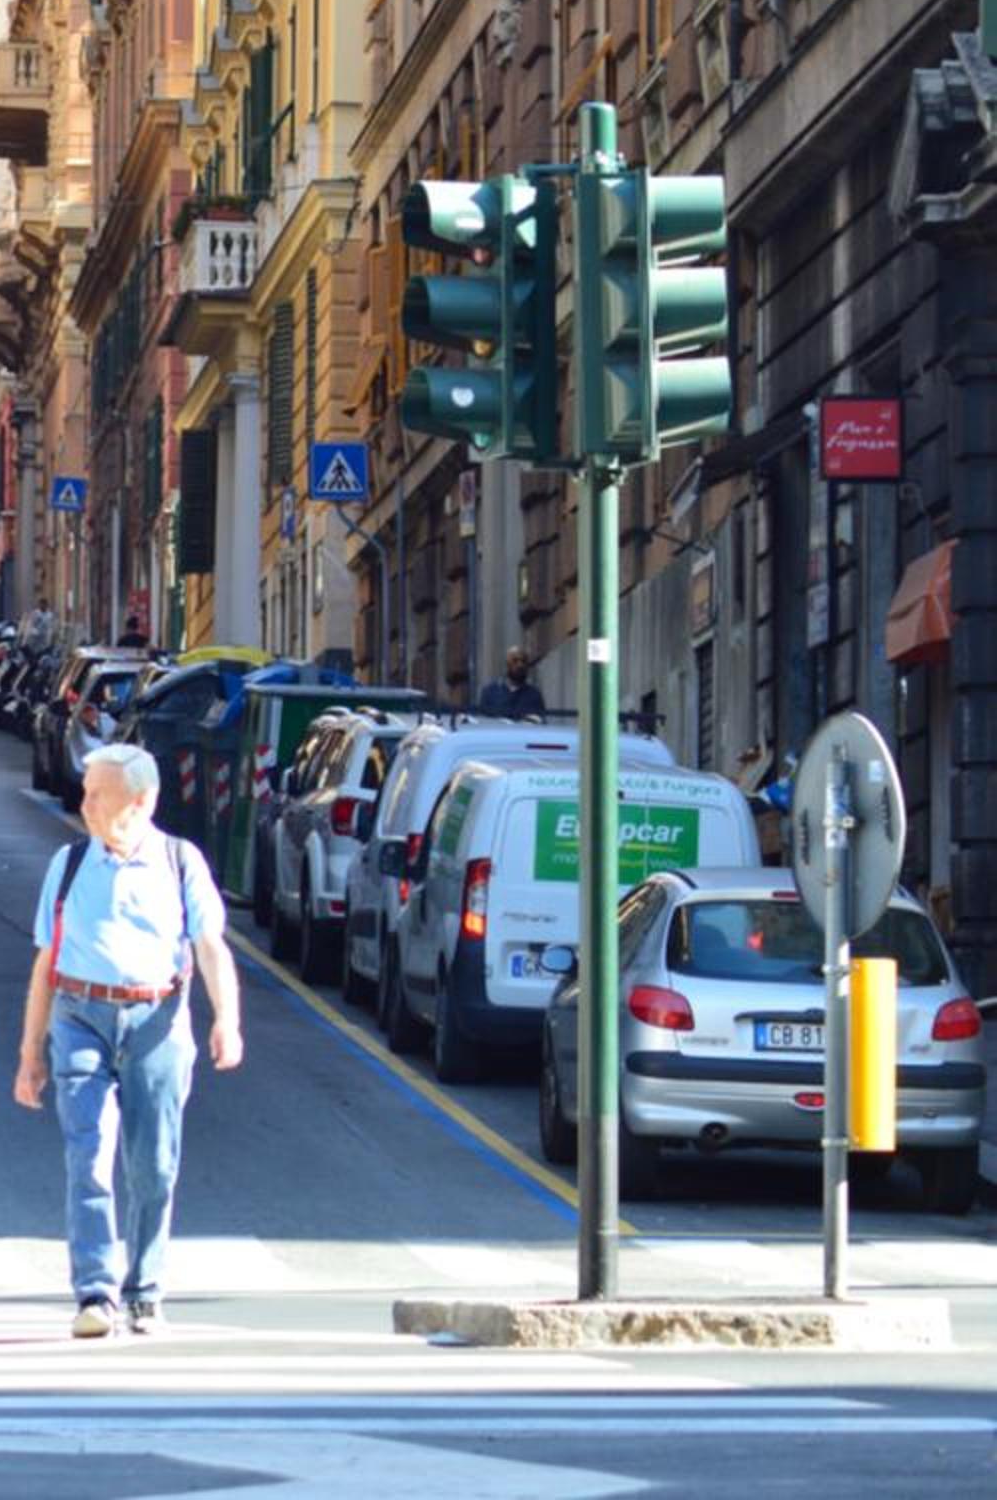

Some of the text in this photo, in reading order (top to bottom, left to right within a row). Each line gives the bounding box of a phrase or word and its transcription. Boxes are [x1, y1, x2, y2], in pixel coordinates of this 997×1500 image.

[555, 813, 684, 845] Epcar
[770, 1026, 824, 1047] CB 81
